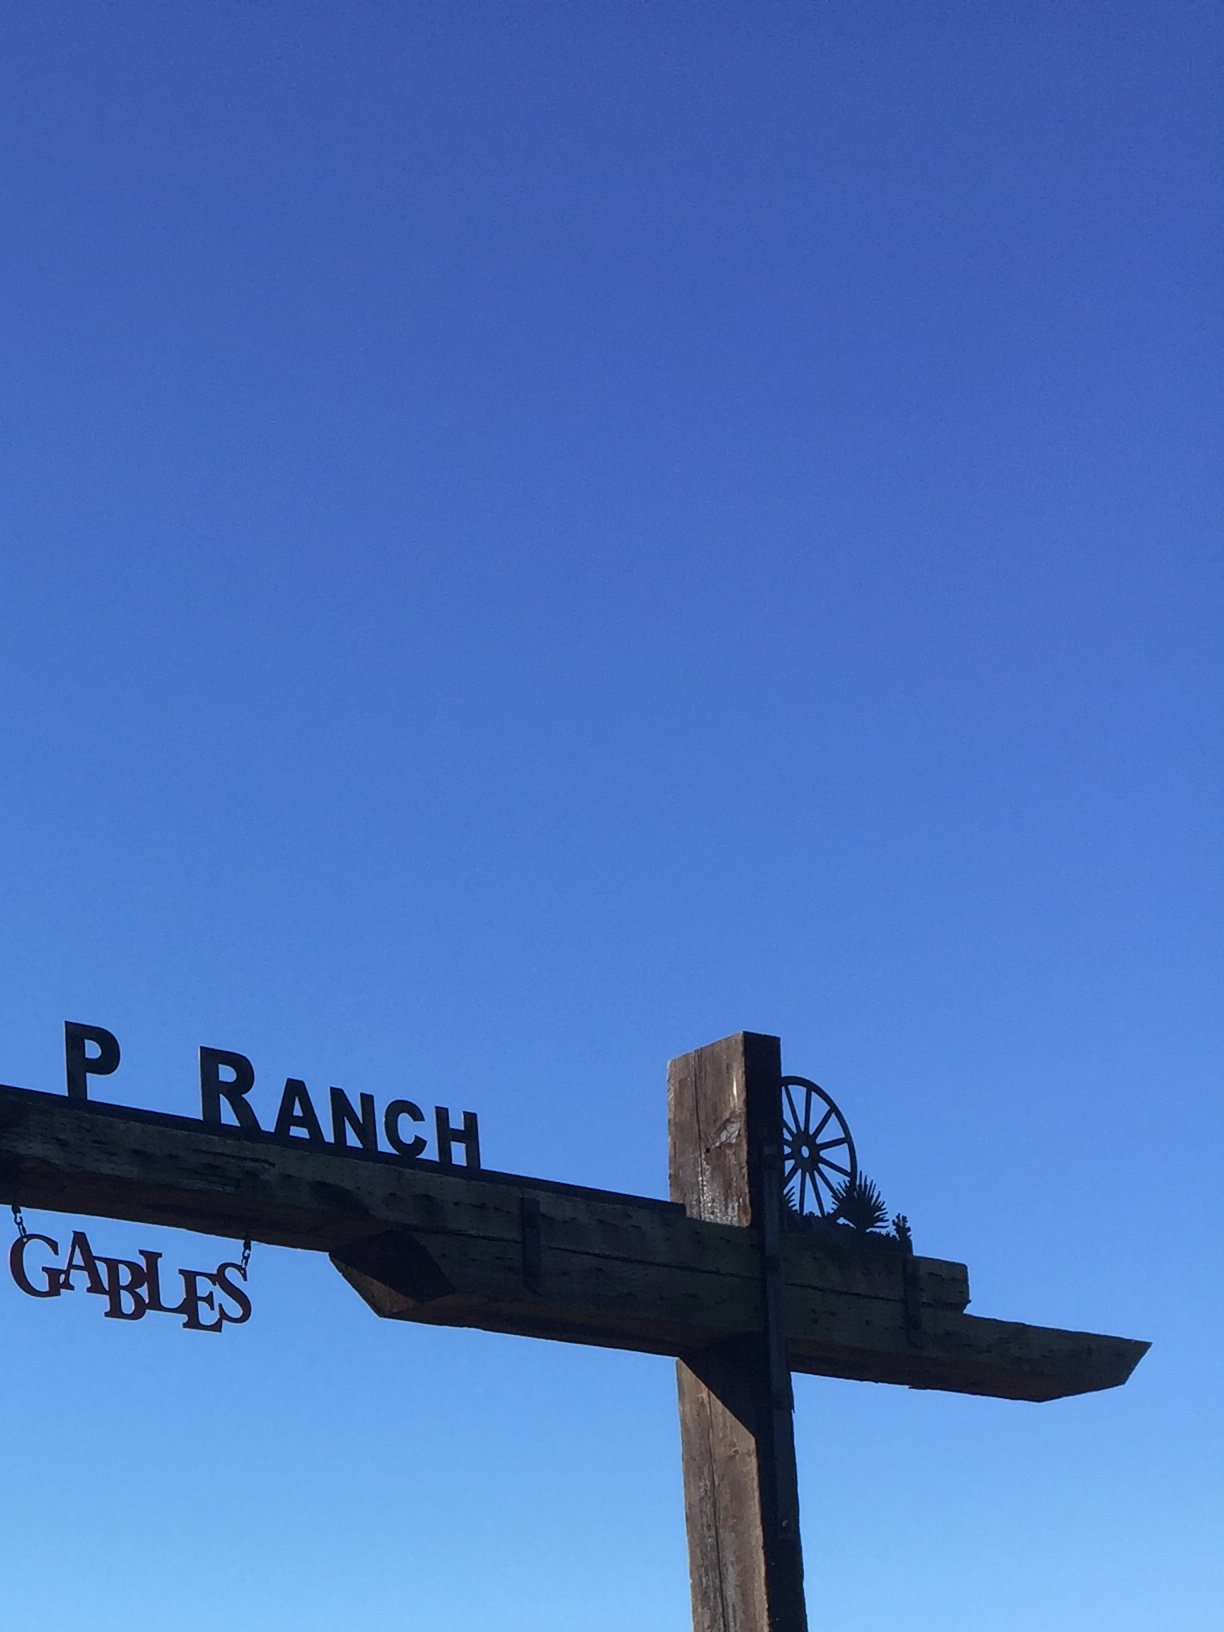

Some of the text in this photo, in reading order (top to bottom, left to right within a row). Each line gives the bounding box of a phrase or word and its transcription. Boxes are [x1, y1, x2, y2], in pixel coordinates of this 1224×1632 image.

[64, 1020, 121, 1101] P
[199, 1045, 481, 1170] RANCH
[9, 1230, 252, 1333] GABLES
